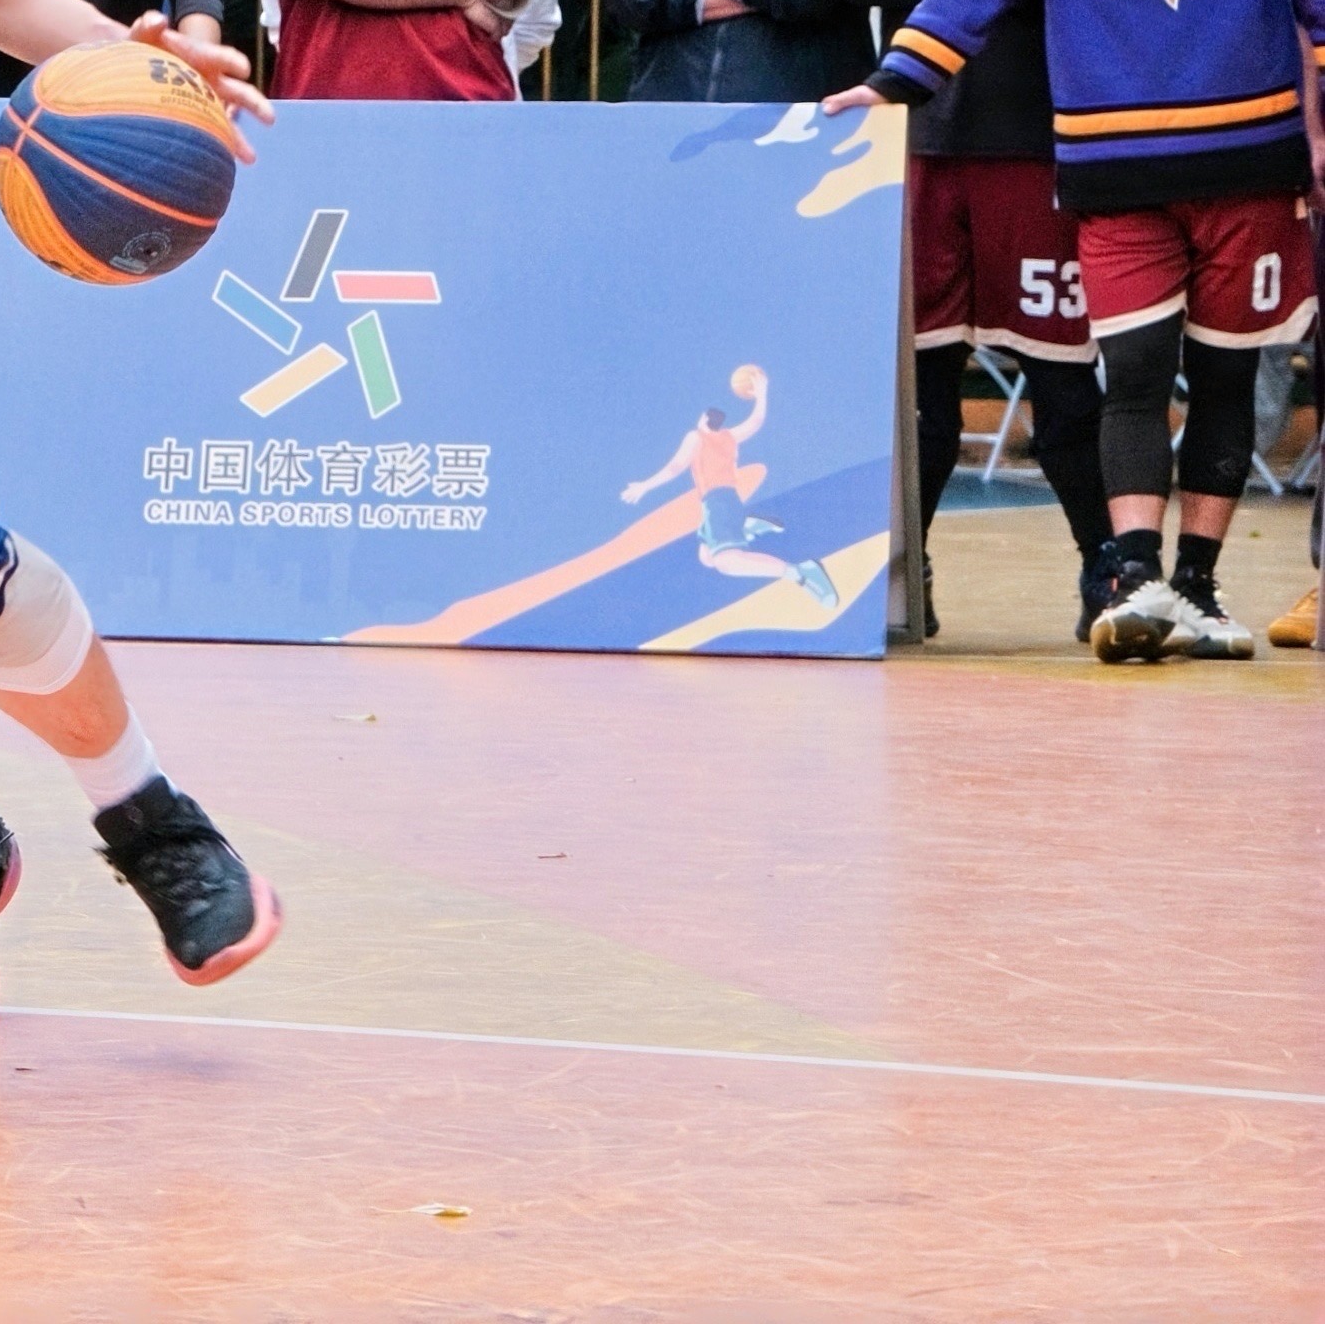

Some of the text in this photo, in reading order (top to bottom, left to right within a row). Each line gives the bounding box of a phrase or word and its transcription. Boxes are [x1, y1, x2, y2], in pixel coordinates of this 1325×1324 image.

[1020, 258, 1087, 317] 53
[143, 437, 491, 498] 中国体育彩票
[144, 499, 489, 531] CHINA SPORTS LOTTERY
